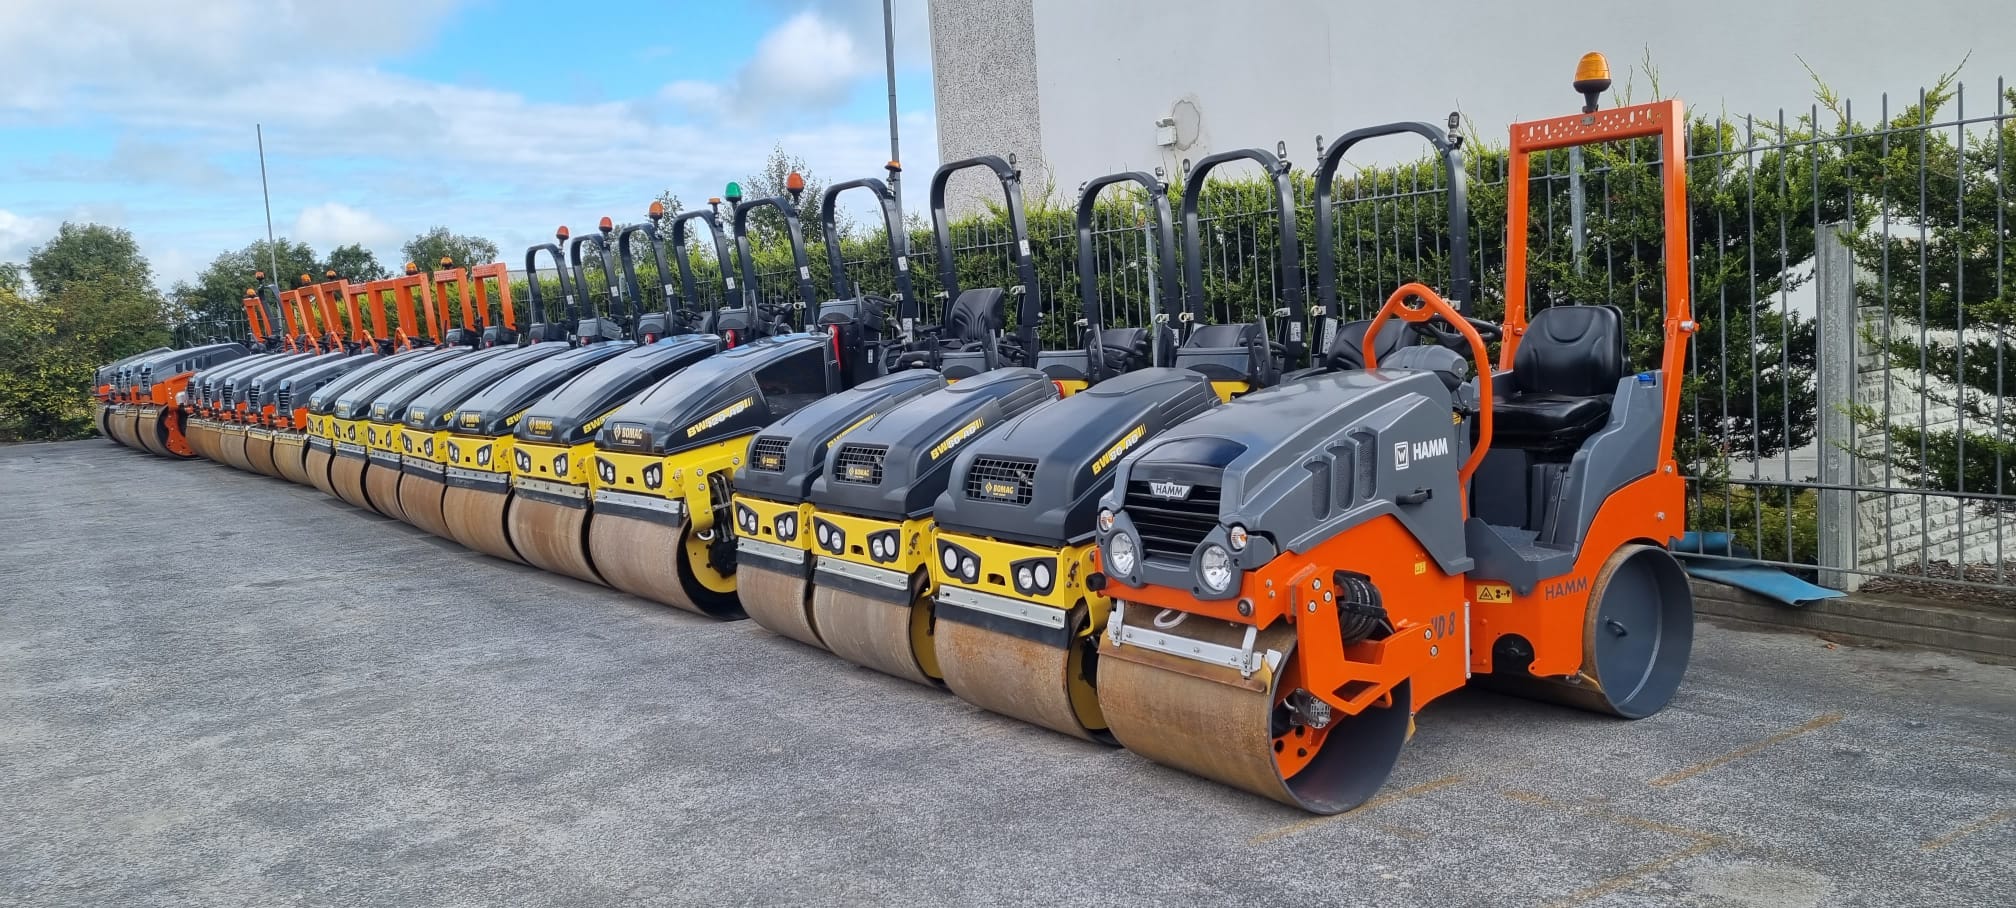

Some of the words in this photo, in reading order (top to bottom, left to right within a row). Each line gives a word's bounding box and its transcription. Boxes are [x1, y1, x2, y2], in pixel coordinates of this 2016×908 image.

[1413, 437, 1448, 461] HAMM
[1156, 484, 1183, 496] HAMM
[1545, 576, 1588, 601] HAMM
[1448, 611, 1456, 636] 8
